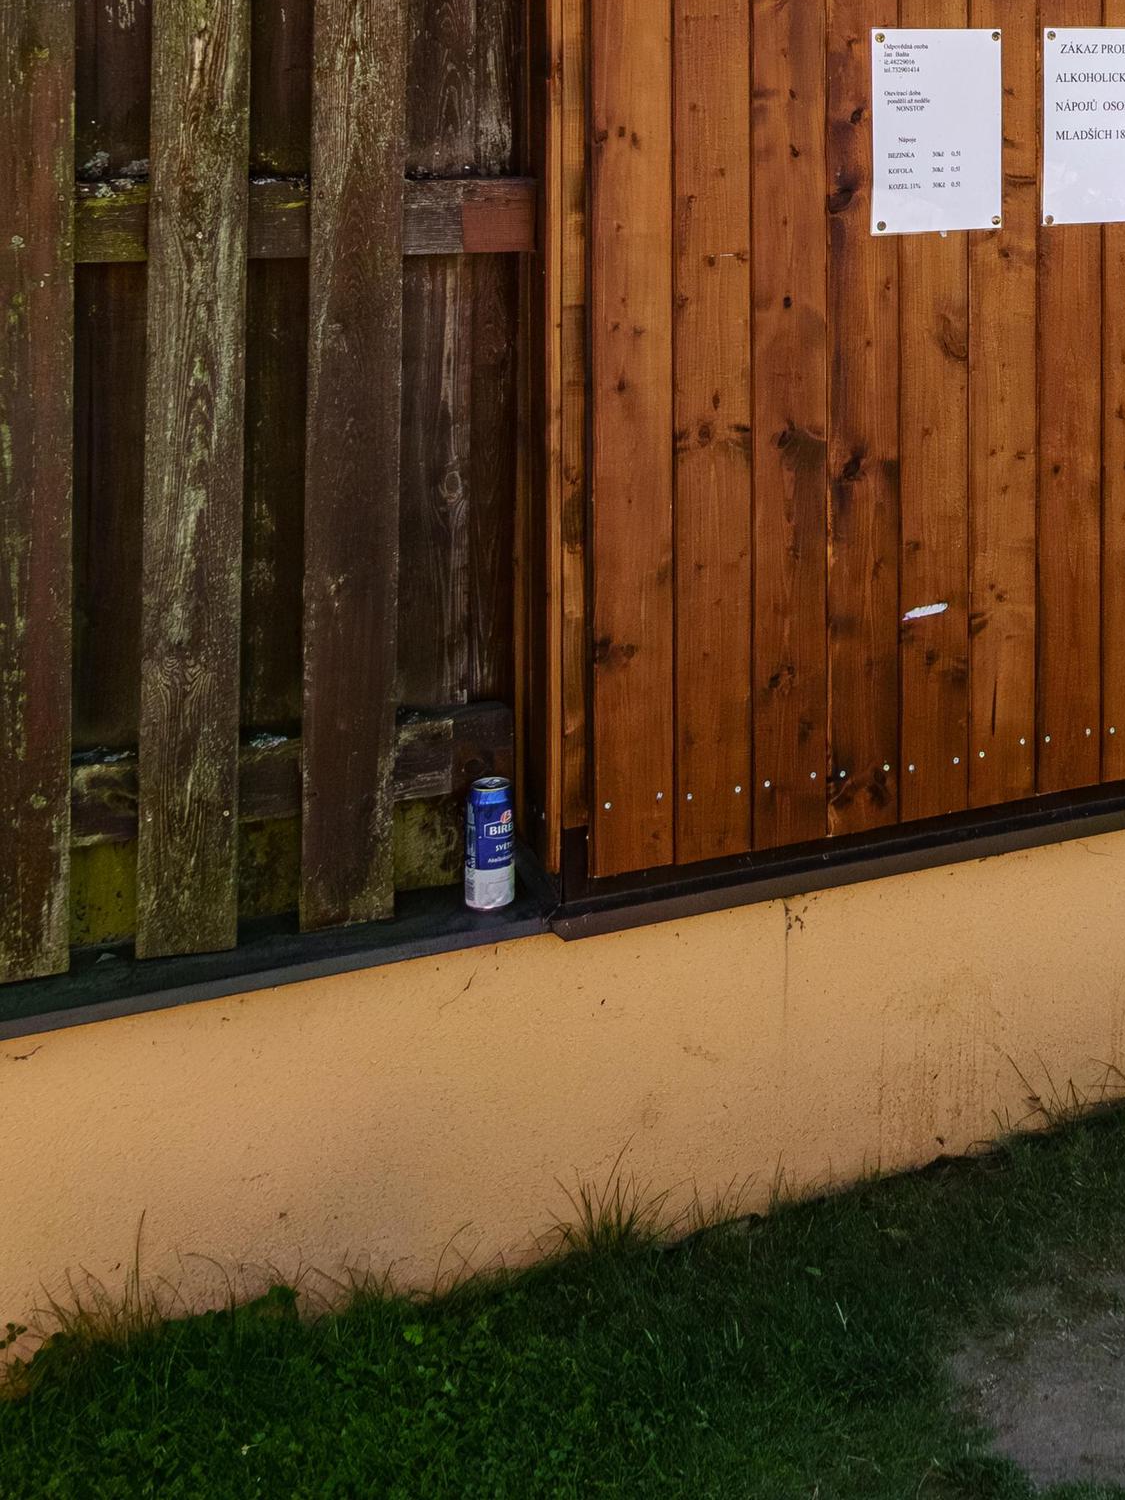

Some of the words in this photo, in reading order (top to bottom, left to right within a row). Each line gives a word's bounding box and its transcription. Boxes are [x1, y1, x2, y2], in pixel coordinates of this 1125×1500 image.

[1060, 41, 1099, 54] ZÁKAZ
[1055, 99, 1098, 112] NÁPOJŮ
[1055, 128, 1112, 141] MLADŠÍCH
[1116, 130, 1125, 140] 18
[489, 822, 514, 836] BIRE
